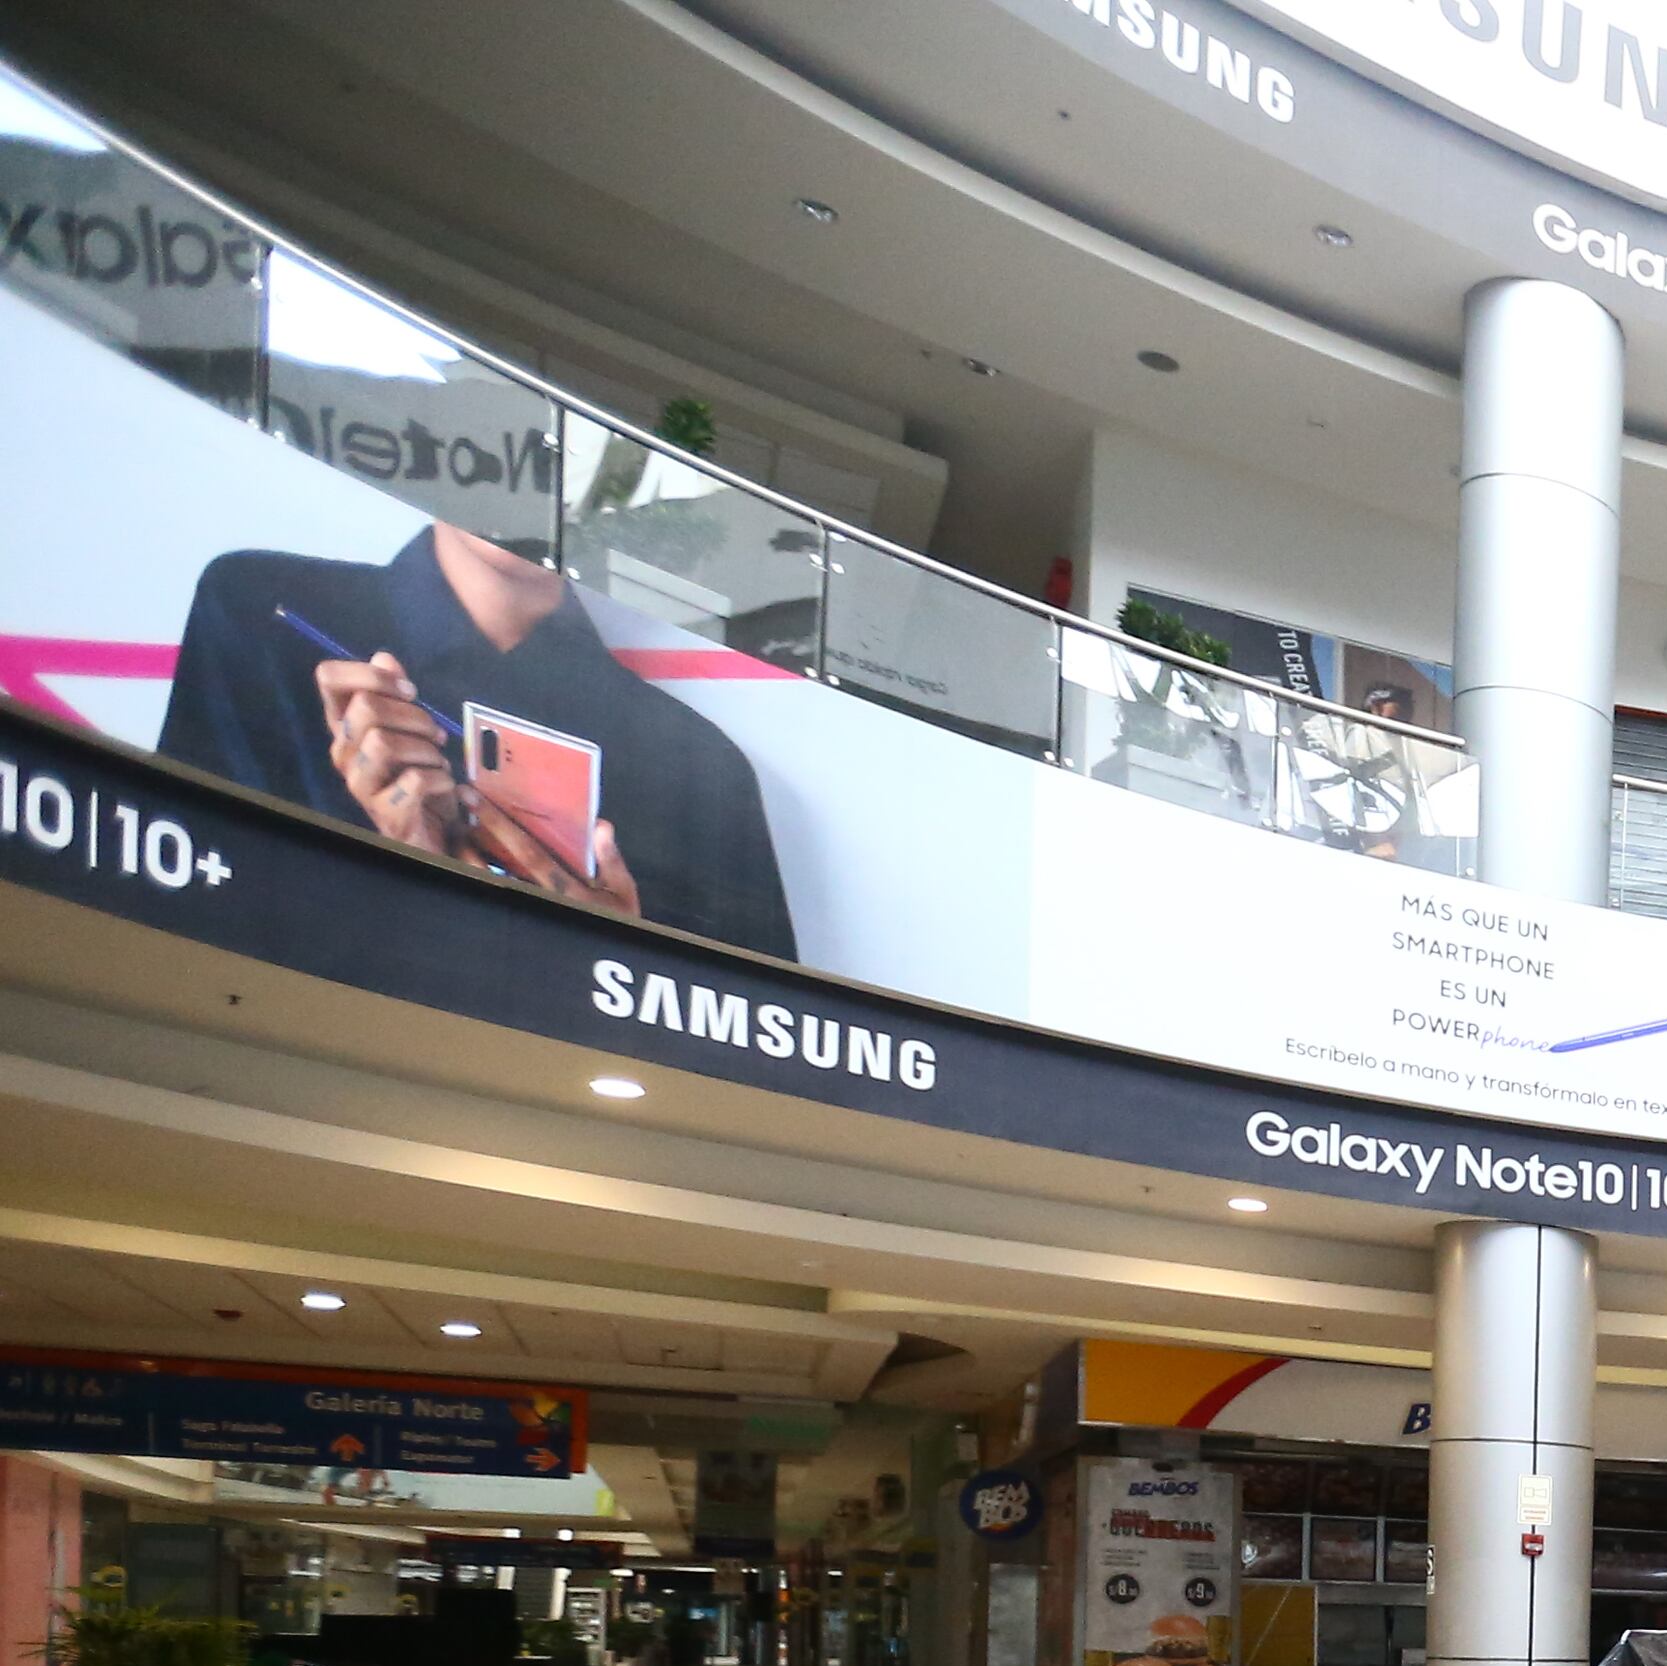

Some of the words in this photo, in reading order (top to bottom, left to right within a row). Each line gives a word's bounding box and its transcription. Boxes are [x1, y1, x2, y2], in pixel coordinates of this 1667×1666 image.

[1278, 631, 1299, 651] TO
[1401, 893, 1454, 922] MÁS
[1461, 907, 1509, 934] QUE
[1517, 918, 1549, 941] UN
[1391, 931, 1556, 981] SMARTPHONE
[1440, 979, 1466, 1000] ES
[1475, 986, 1507, 1008] UN
[591, 957, 937, 1092] SAMSUNG
[1285, 1037, 1377, 1071] Escríbelo
[1382, 1058, 1396, 1073] a
[1401, 1060, 1460, 1085] mano
[1465, 1073, 1477, 1091] y
[1482, 1072, 1609, 1108] transfórmalo
[1613, 1096, 1638, 1111] en
[1245, 1109, 1445, 1194] Galaxy
[411, 1399, 486, 1423] Norte
[1127, 1481, 1200, 1497] BEMBOS
